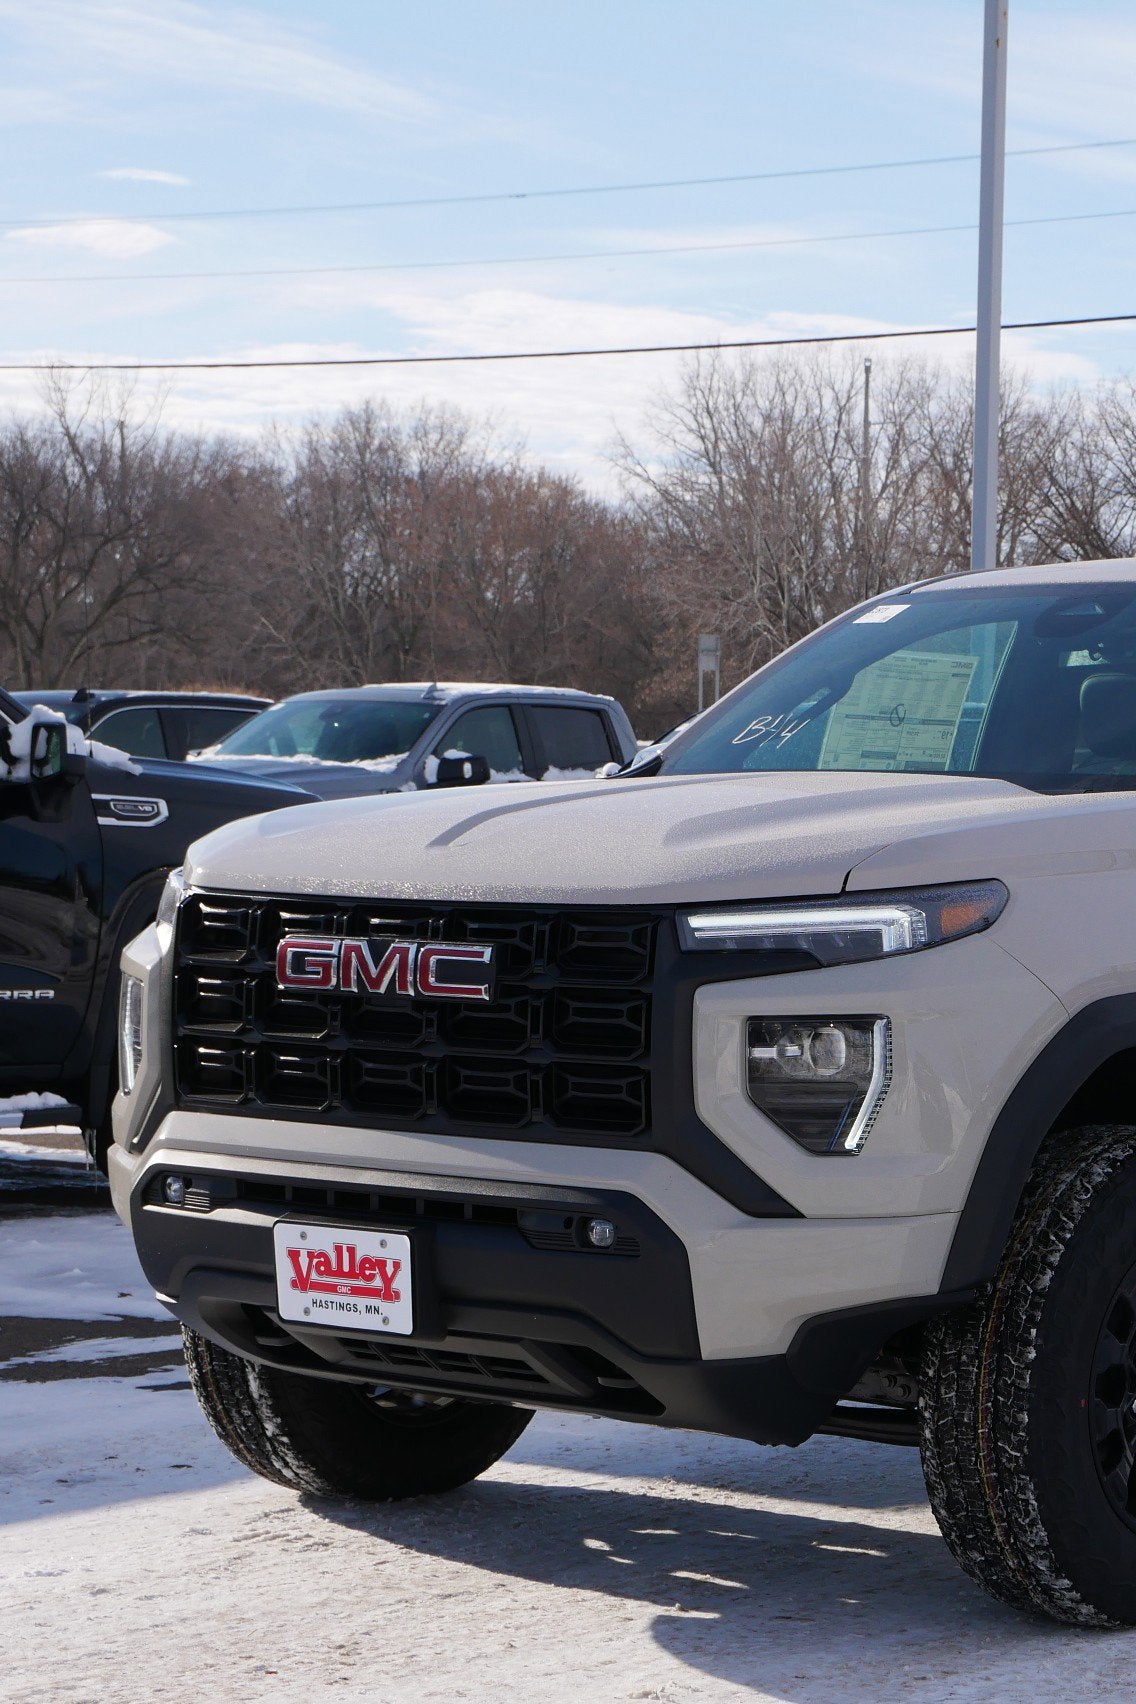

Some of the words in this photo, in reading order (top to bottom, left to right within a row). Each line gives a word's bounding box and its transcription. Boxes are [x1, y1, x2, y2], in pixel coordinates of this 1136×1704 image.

[276, 938, 492, 1000] GMC
[286, 1242, 402, 1303] Valley
[337, 1285, 351, 1294] GMC
[311, 1298, 362, 1315] HASTINGS,
[365, 1304, 384, 1316] MN.
